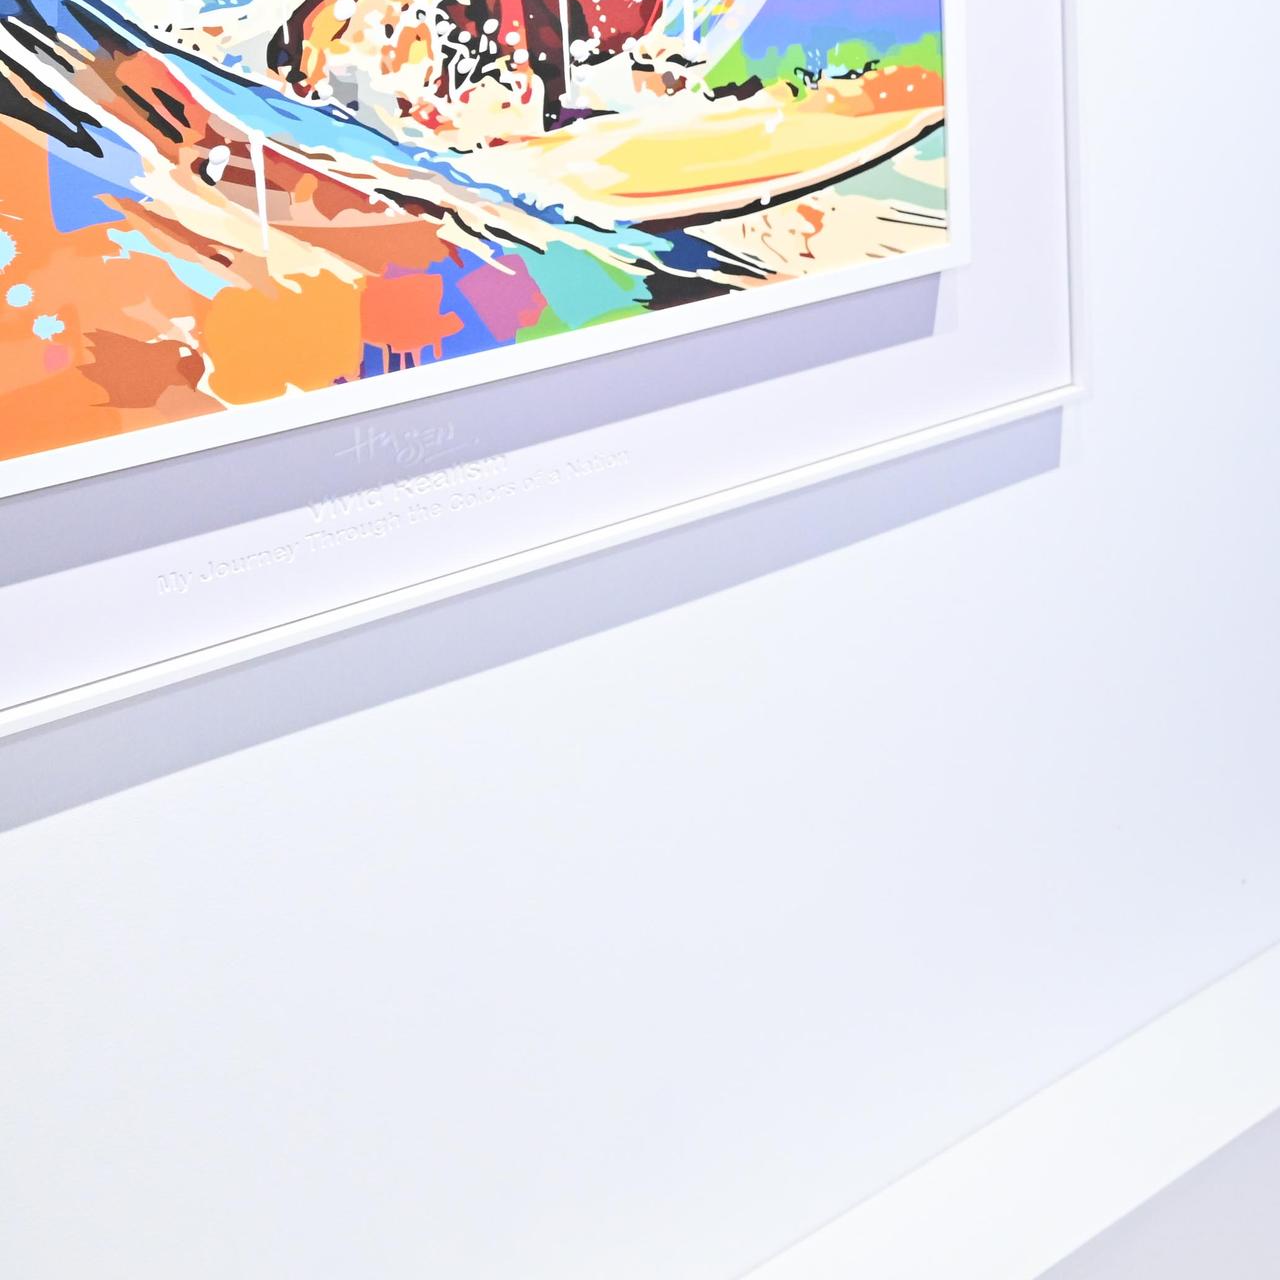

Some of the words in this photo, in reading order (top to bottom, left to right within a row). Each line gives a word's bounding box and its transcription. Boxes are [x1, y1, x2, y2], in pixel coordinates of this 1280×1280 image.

[154, 569, 193, 596] My
[199, 541, 299, 584] Journey
[304, 511, 401, 552] Through
[408, 501, 442, 525] the
[448, 481, 520, 513] Colors
[522, 469, 545, 492] of
[565, 448, 632, 480] Nation
[306, 485, 383, 525] Vivid
[392, 454, 509, 502] Realism
